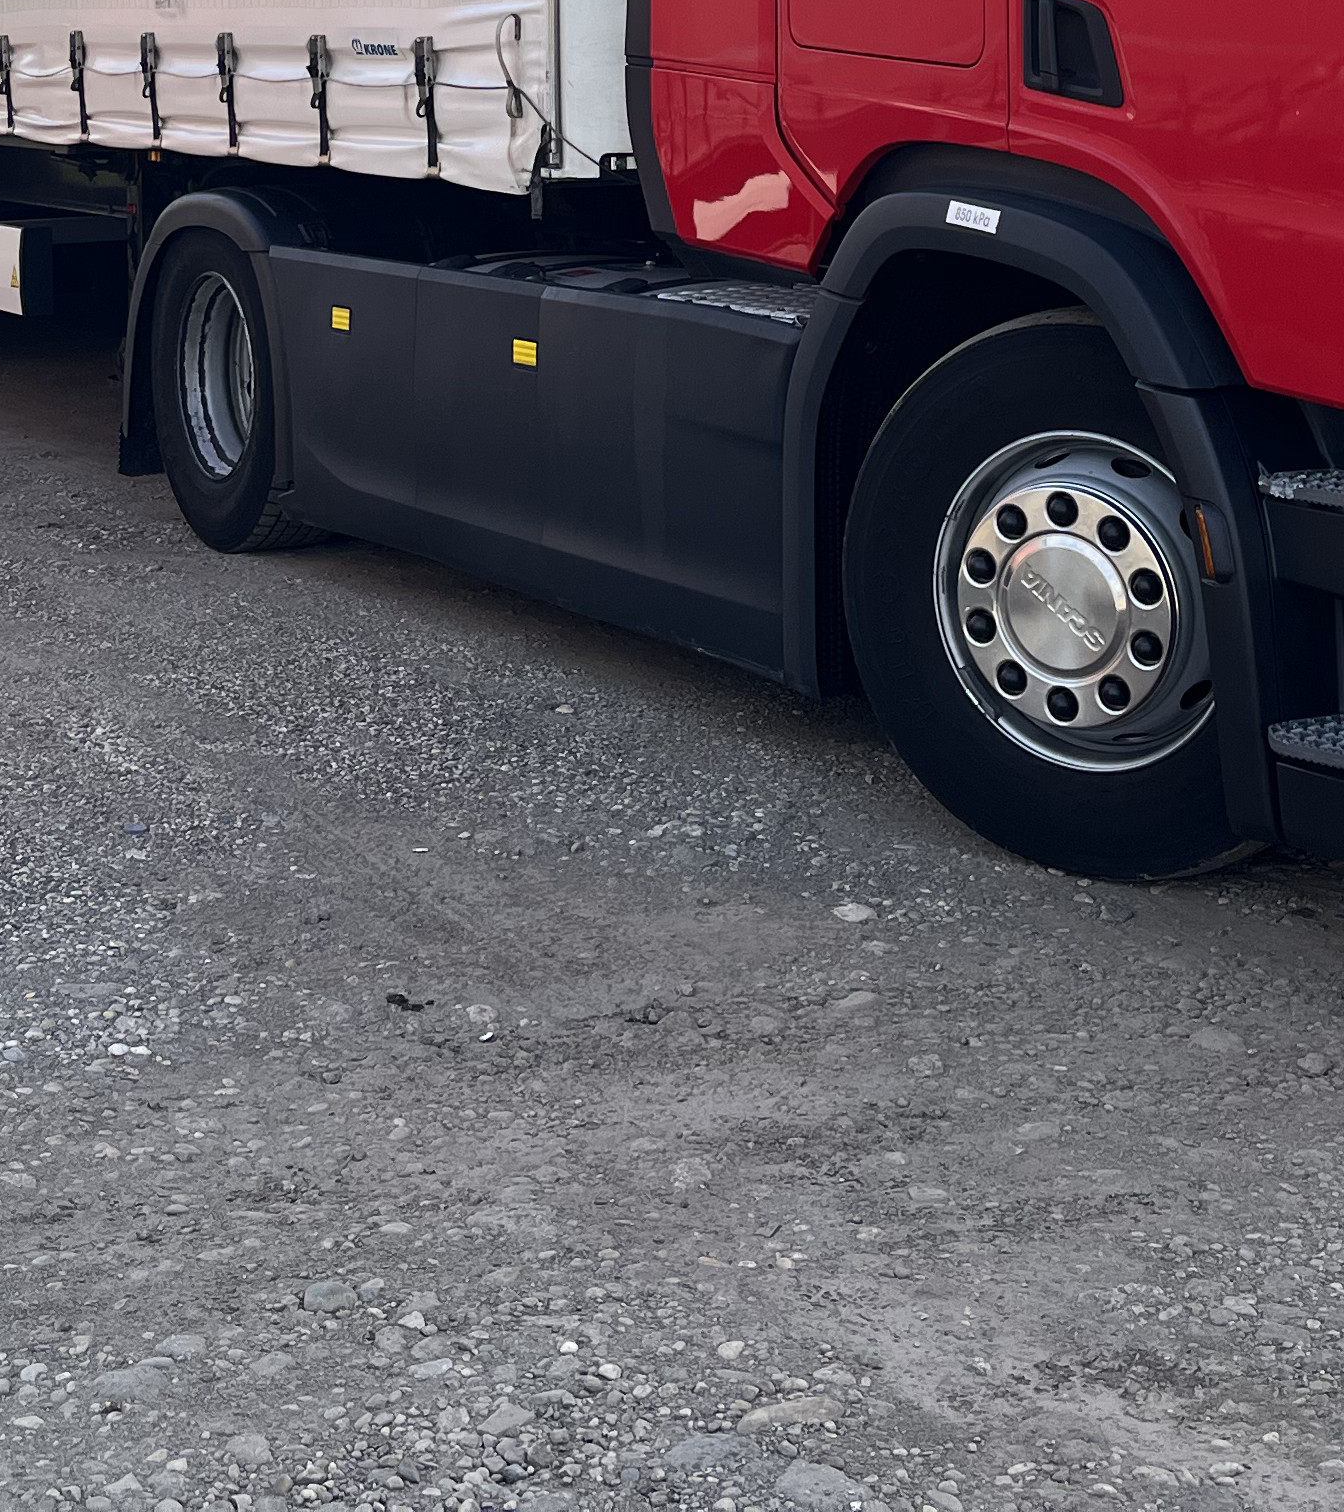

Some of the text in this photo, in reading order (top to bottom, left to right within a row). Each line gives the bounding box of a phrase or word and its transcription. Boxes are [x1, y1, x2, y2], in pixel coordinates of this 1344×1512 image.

[363, 43, 398, 56] KRONE
[955, 207, 990, 227] 850 kPa
[1021, 562, 1106, 652] SCANIA
